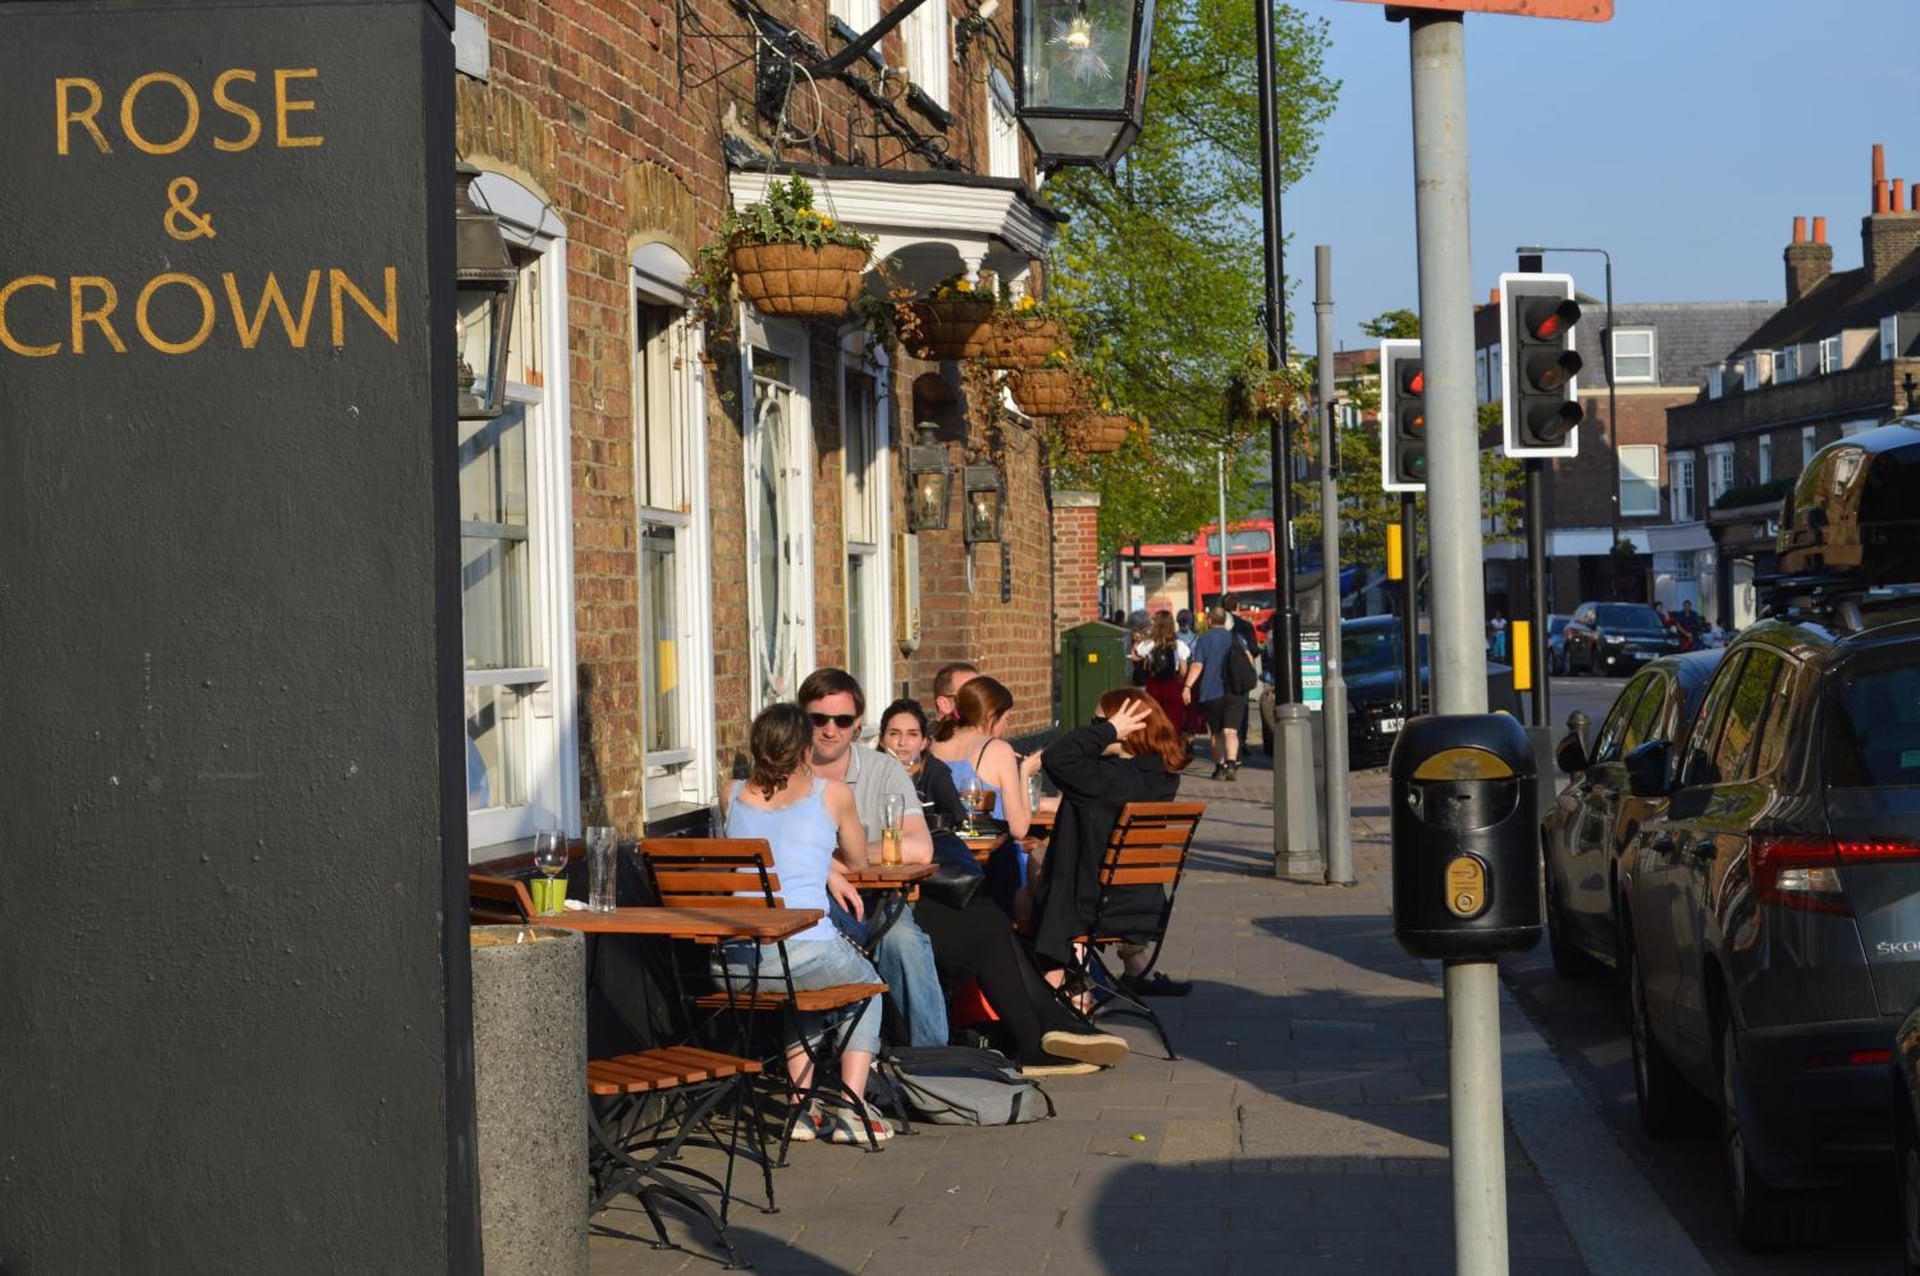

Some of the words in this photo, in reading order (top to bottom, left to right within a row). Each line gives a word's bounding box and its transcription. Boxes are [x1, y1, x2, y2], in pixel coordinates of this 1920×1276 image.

[56, 68, 324, 155] ROSE
[164, 176, 217, 241] &
[0, 266, 398, 357] CROWN
